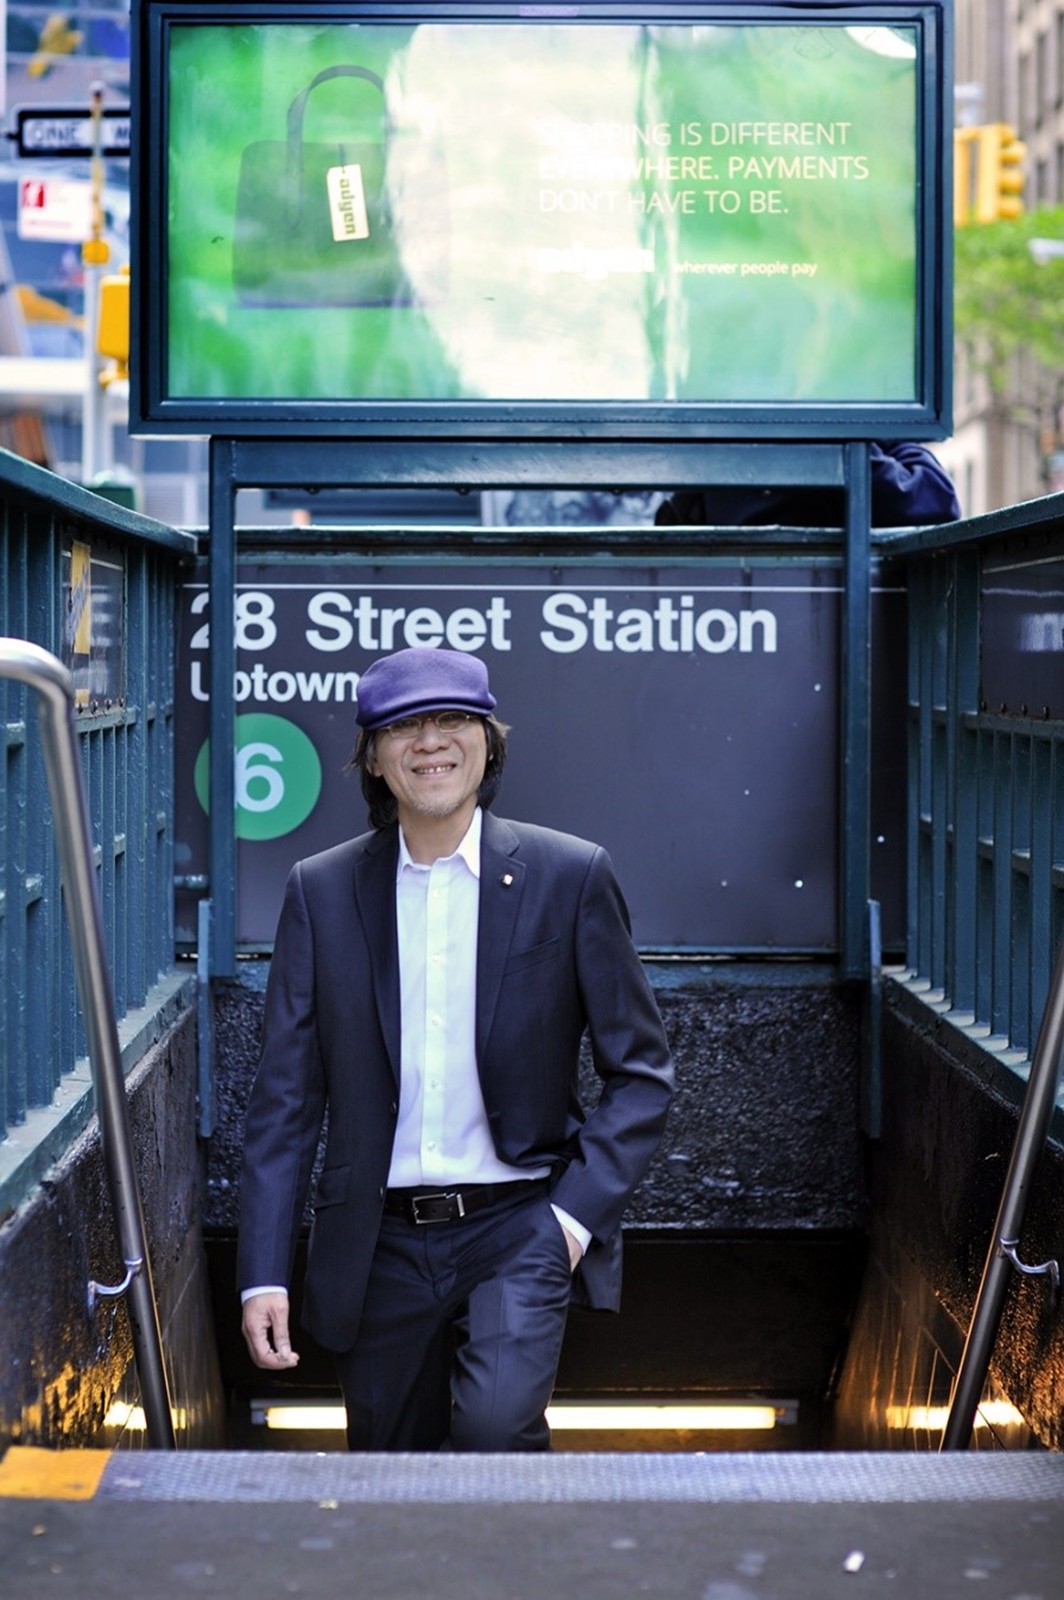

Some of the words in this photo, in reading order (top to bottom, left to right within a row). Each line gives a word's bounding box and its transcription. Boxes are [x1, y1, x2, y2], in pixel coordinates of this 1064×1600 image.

[681, 122, 702, 146] IS
[711, 122, 851, 146] DIFFERENT
[728, 156, 869, 180] PAYMENTS
[338, 179, 356, 235] adyen
[540, 190, 618, 214] DON'T
[628, 190, 696, 214] HAVE
[704, 190, 741, 214] TO
[749, 190, 788, 214] BE.
[671, 260, 737, 275] wherever
[740, 260, 789, 277] people
[791, 262, 817, 277] pay
[305, 591, 511, 652] Street
[540, 592, 777, 653] Station
[233, 742, 285, 813] 6
